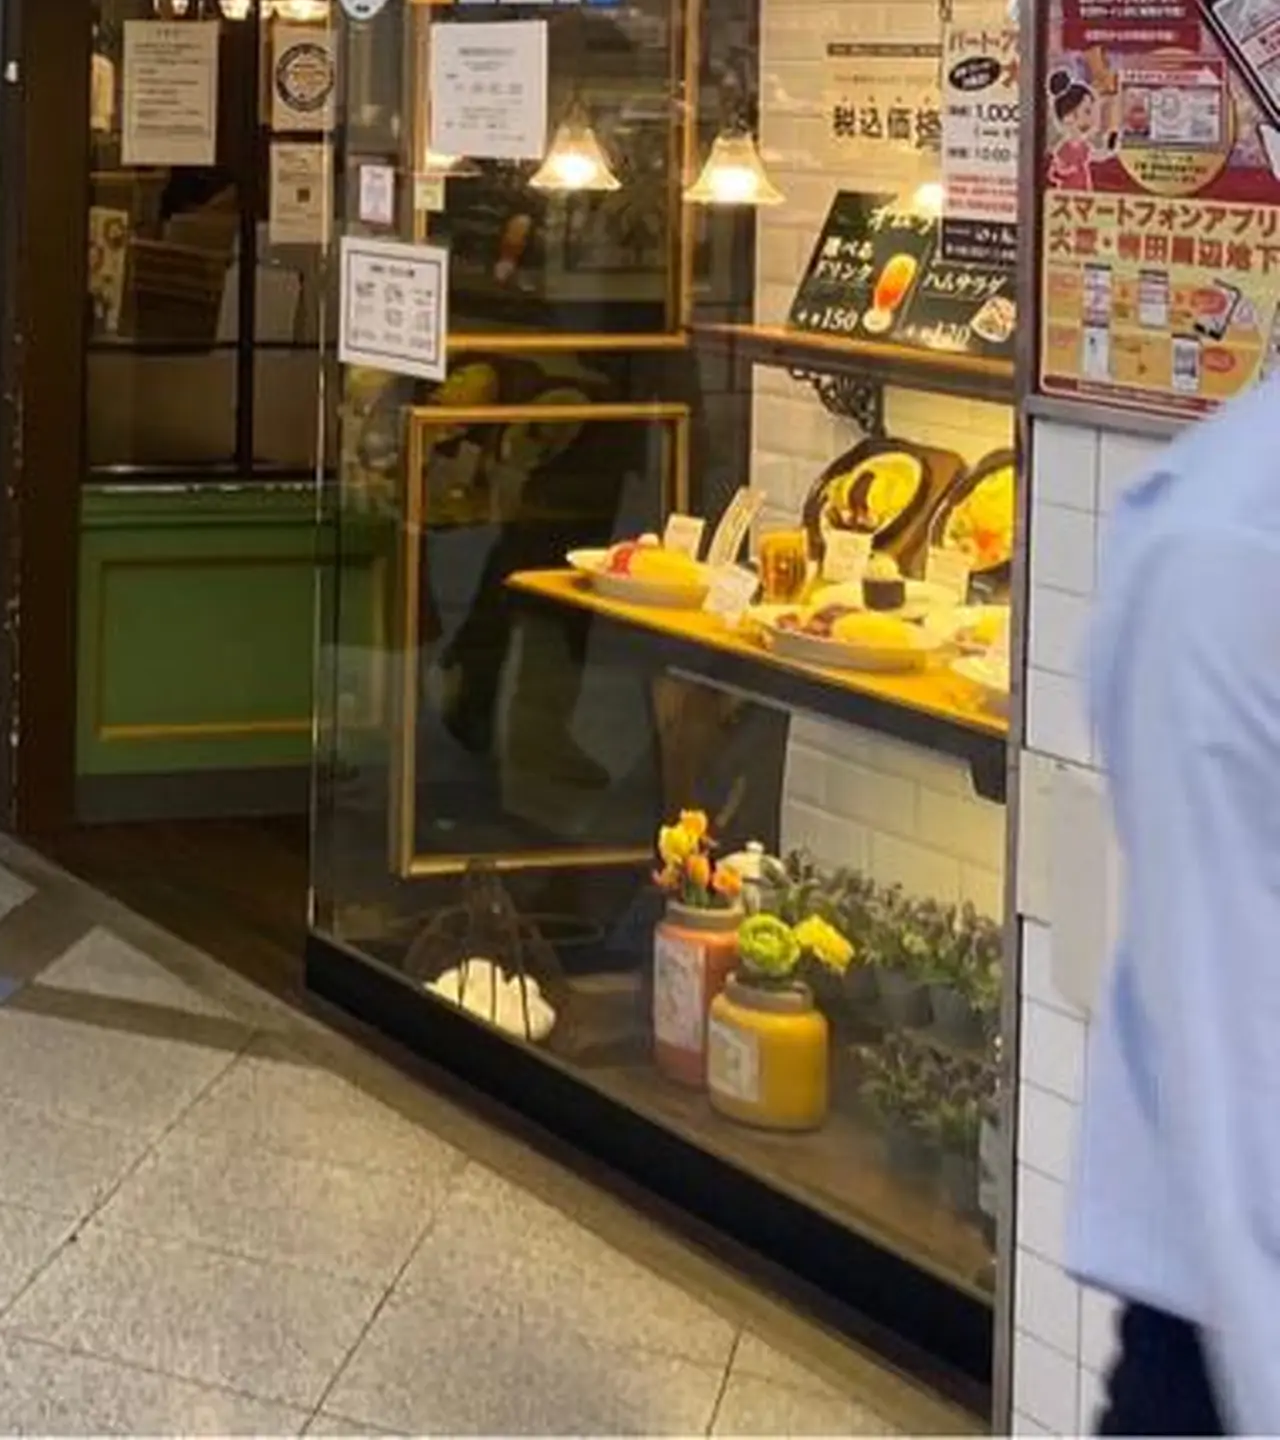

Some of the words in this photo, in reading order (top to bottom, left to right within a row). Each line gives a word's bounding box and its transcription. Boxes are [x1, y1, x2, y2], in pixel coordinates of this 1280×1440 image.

[1051, 195, 1277, 238] スマートフォンアプリ
